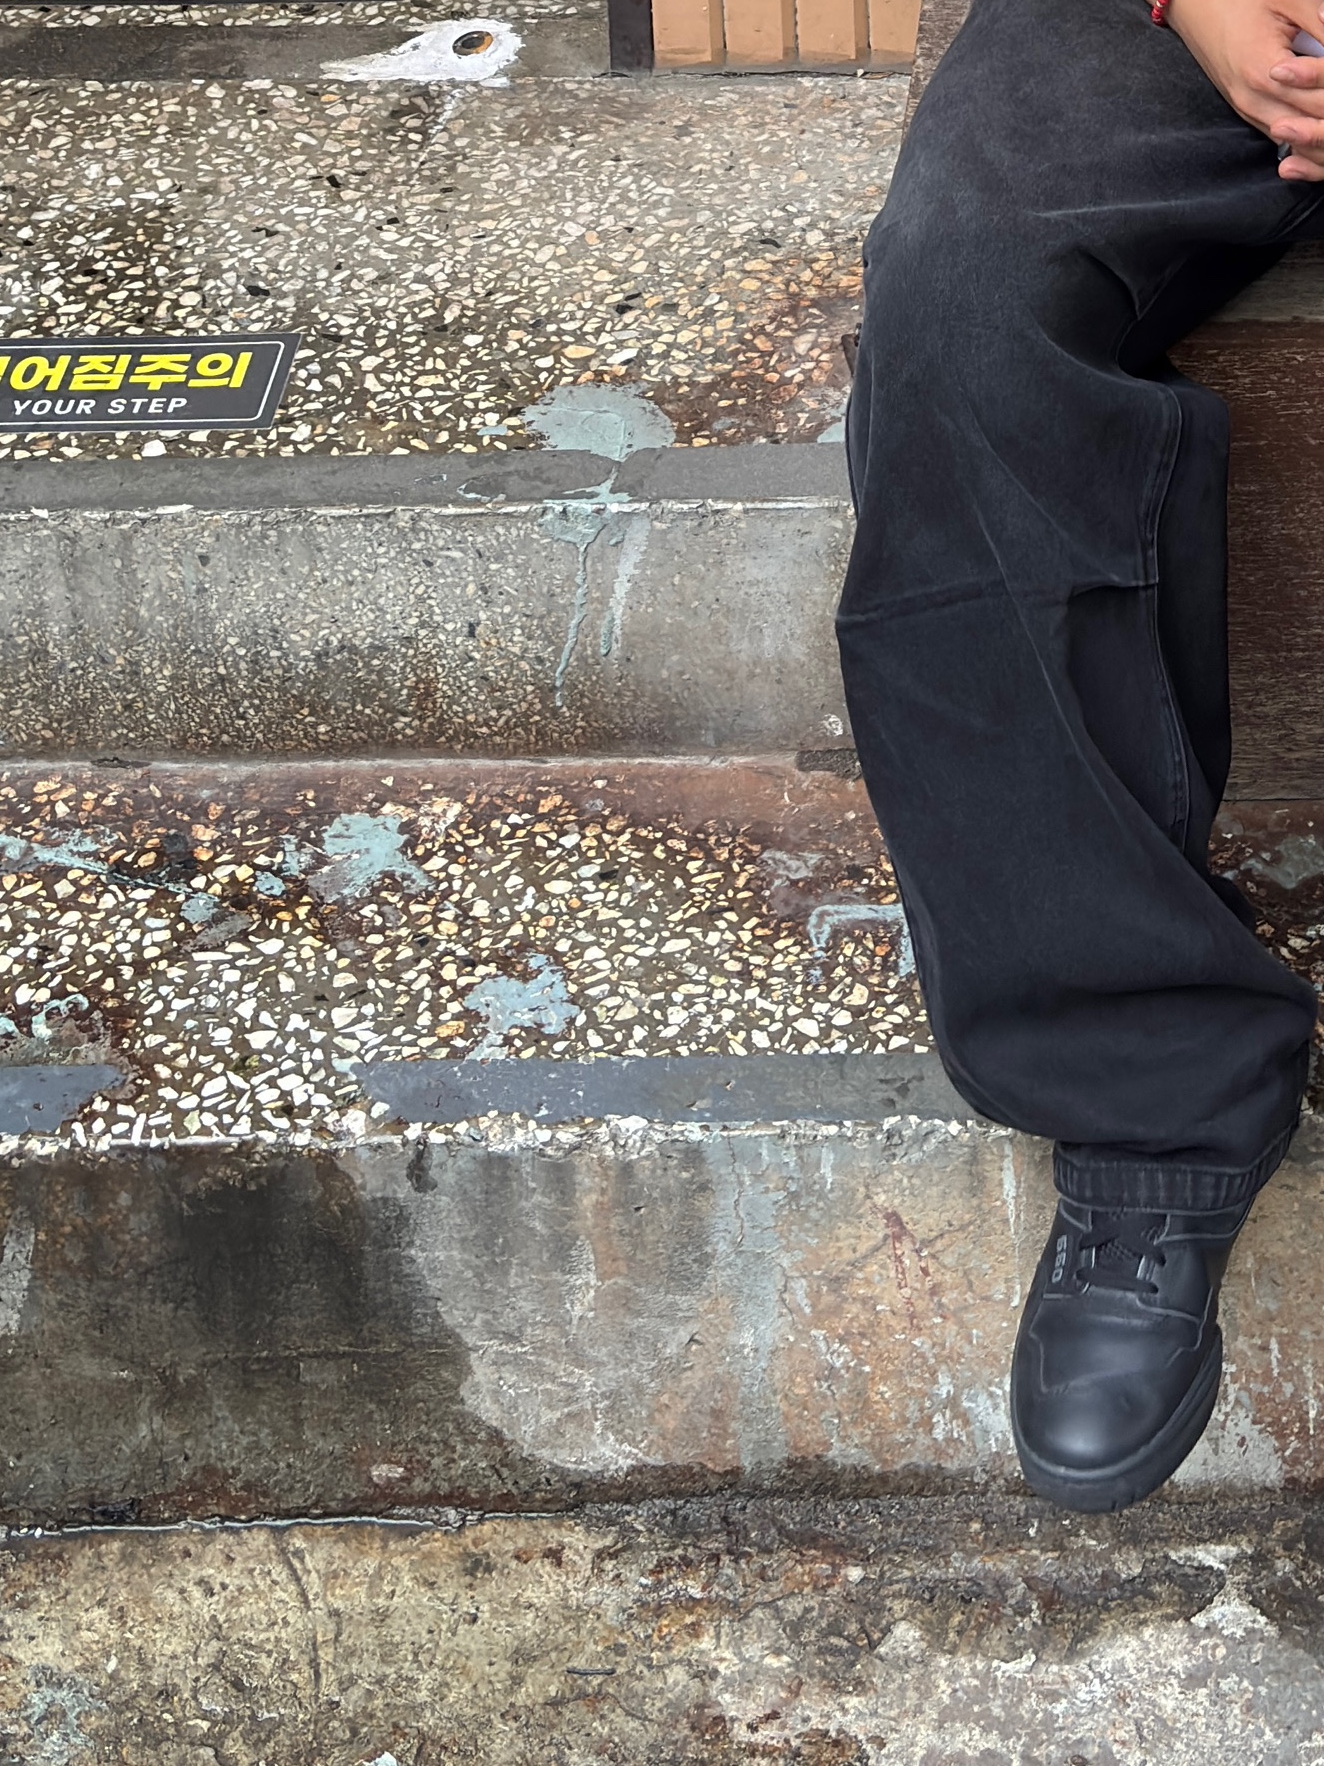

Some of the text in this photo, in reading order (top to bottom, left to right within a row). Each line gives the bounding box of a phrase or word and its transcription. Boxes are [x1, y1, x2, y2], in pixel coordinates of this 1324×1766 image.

[0, 351, 253, 392] 어짐주의
[12, 397, 189, 416] YOUR STEP
